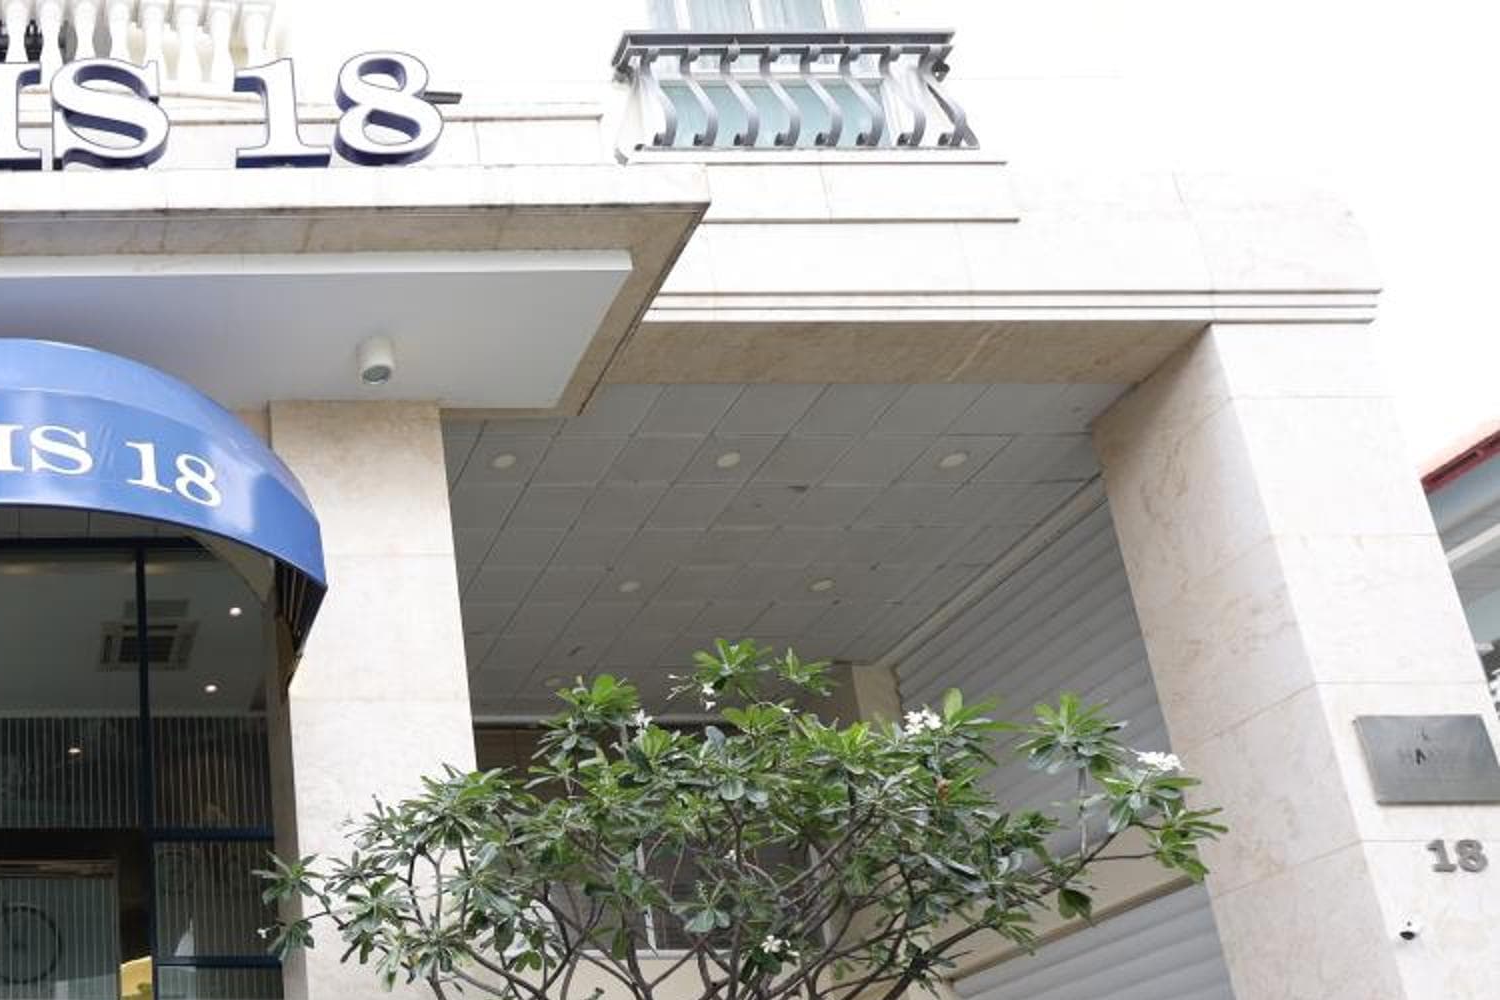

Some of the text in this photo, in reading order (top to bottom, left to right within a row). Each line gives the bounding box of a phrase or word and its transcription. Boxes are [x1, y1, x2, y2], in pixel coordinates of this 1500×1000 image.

[233, 51, 444, 168] 18
[126, 441, 222, 507] 18
[1427, 839, 1488, 873] 18
